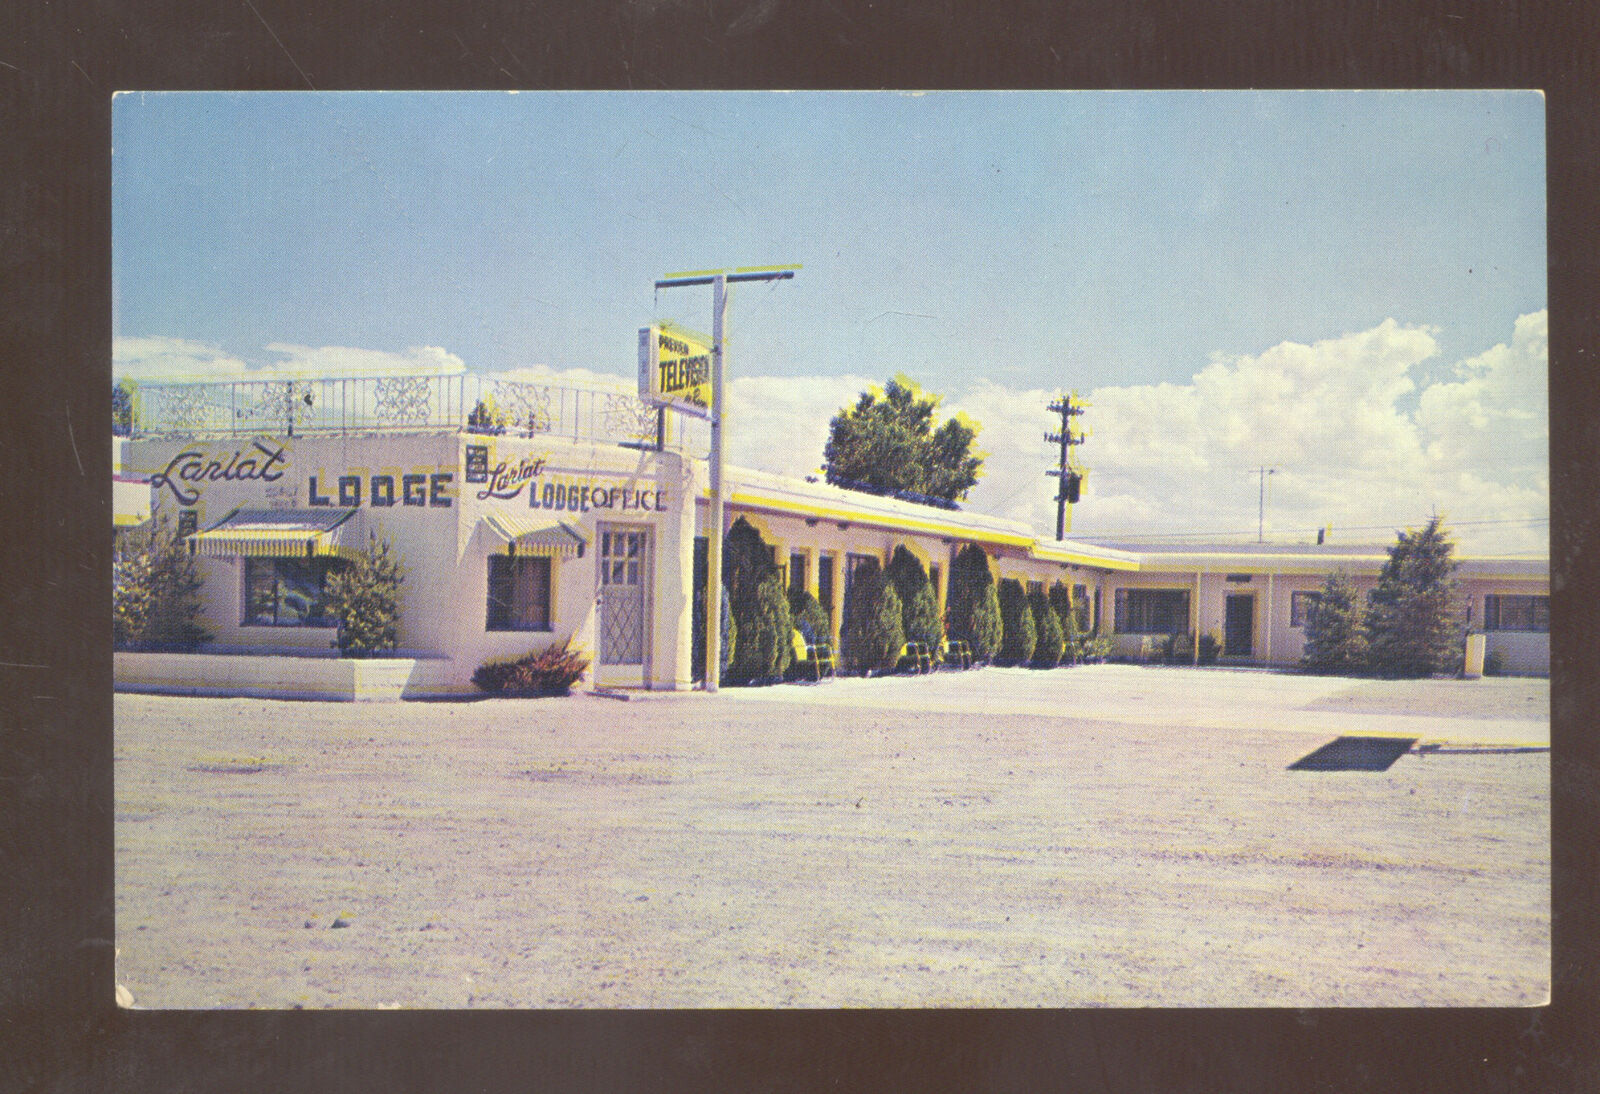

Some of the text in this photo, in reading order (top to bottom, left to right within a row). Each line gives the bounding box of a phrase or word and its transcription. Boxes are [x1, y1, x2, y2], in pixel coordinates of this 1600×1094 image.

[144, 441, 453, 508] Lariat LODGE
[476, 458, 546, 501] Lariat
[529, 481, 668, 512] LODGE OFFICE
